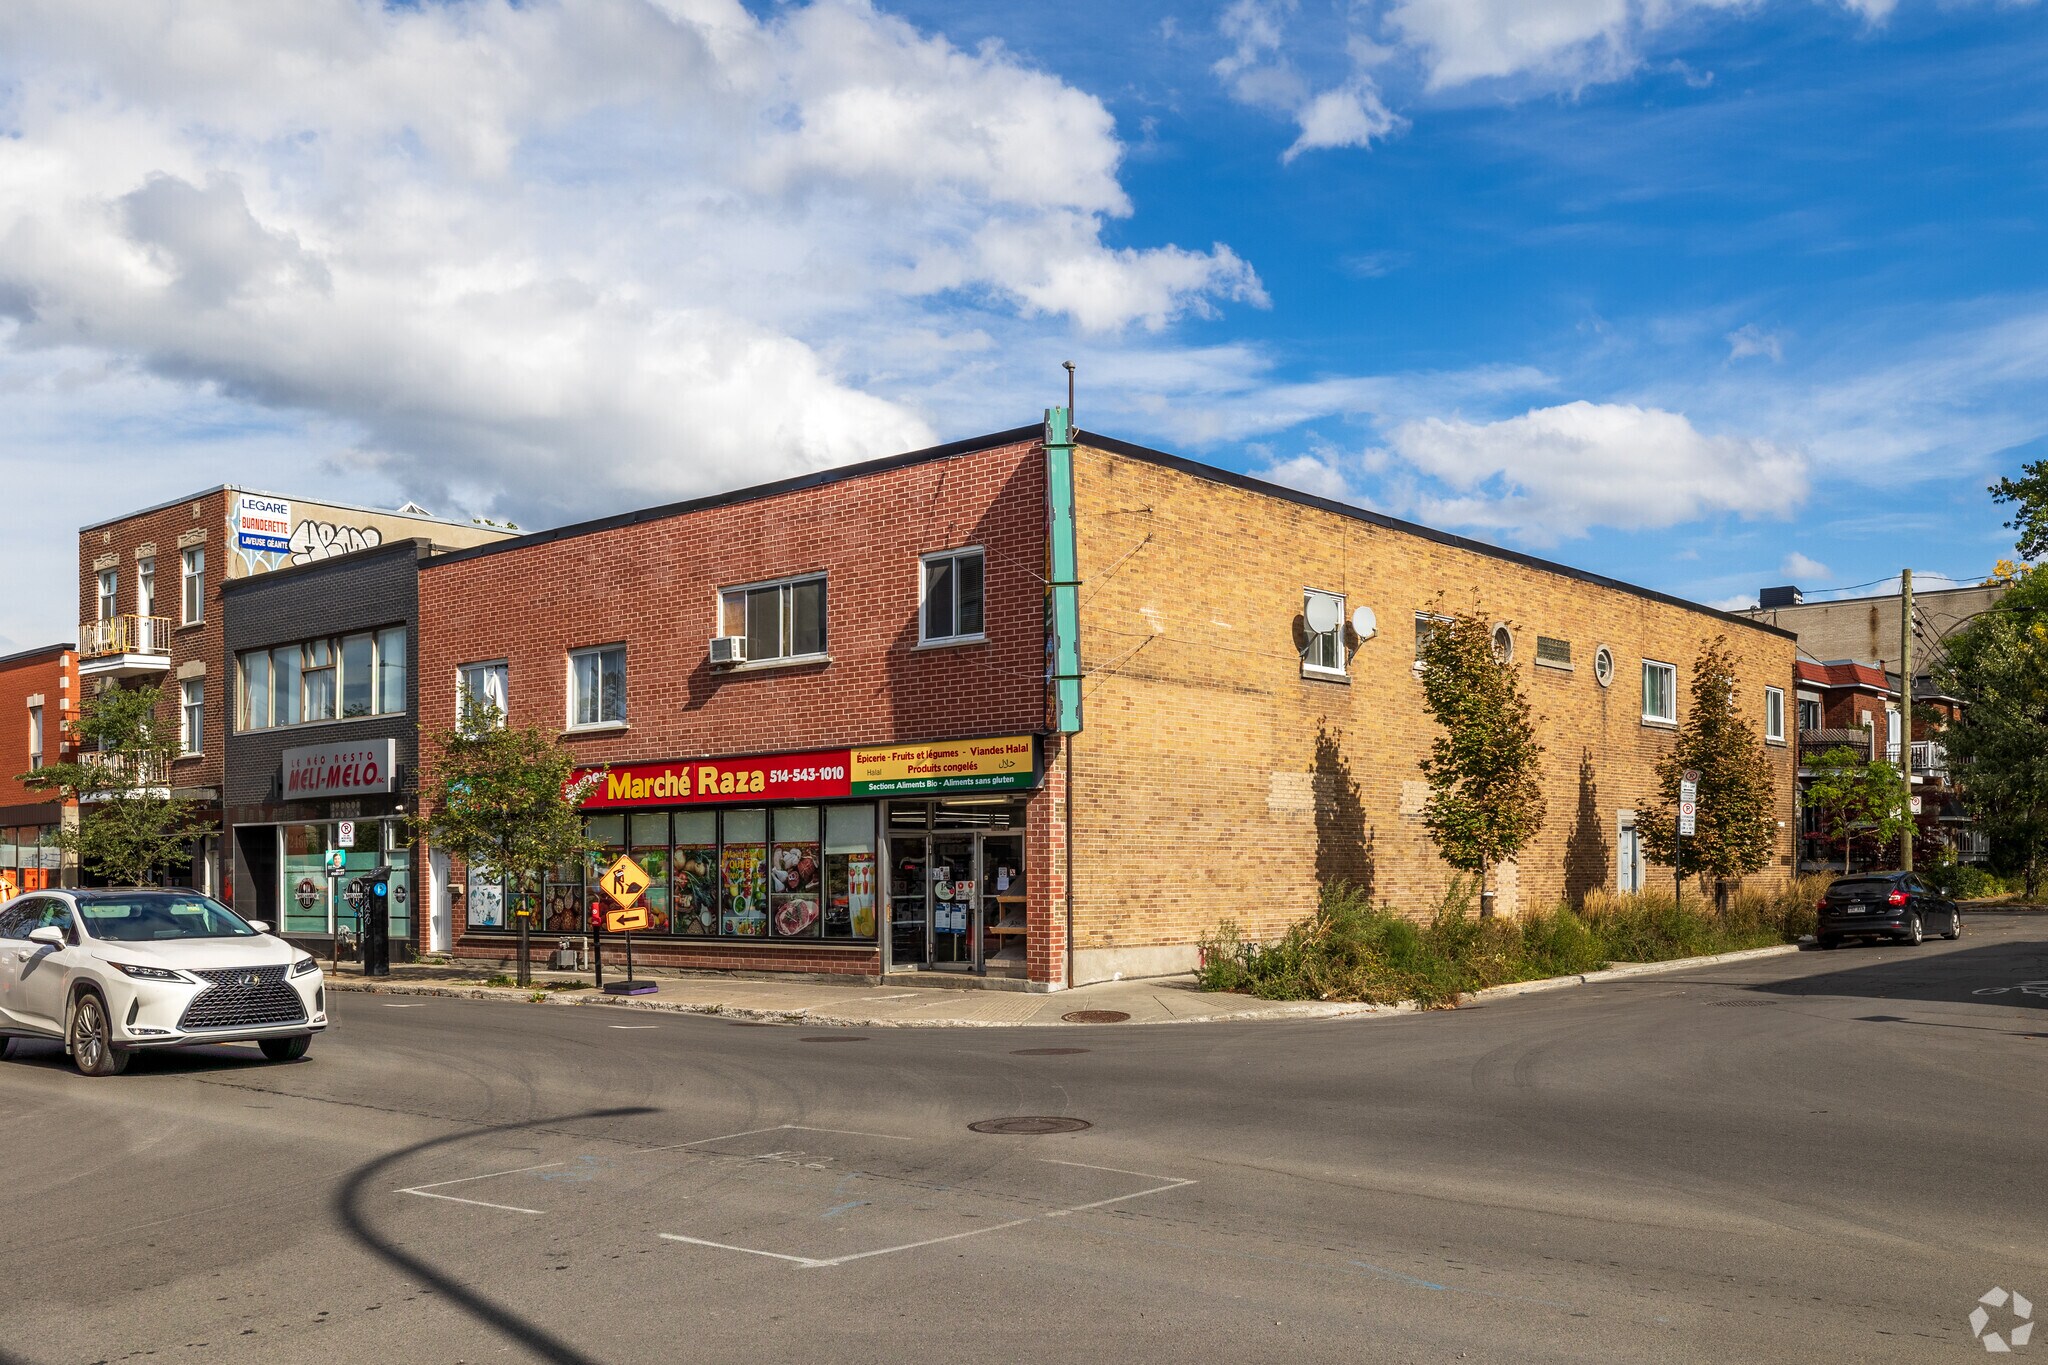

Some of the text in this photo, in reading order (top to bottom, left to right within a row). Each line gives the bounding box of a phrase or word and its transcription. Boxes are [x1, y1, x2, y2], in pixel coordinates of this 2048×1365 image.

[242, 499, 288, 515] LEGARE
[242, 516, 288, 535] BUANDERETTE
[242, 535, 288, 550] LAVEUSE GÉANTE
[291, 759, 300, 768] LE
[334, 751, 373, 764] RESTO
[856, 752, 886, 764] Épicerie
[892, 751, 915, 762] Fruits
[916, 751, 925, 760] et
[926, 749, 959, 760] légumes
[970, 745, 1004, 756] Viandes
[1006, 743, 1029, 753] Halal
[866, 768, 882, 776] Halal
[907, 761, 978, 774] Produits congelés
[607, 766, 691, 800] Marché
[698, 766, 766, 795] Raza
[769, 765, 845, 783] 514-543-1010
[868, 782, 895, 791] Sections
[896, 780, 926, 789] Aliments
[926, 779, 938, 788] Bio
[943, 777, 974, 787] Aliments
[975, 777, 991, 785] sans
[992, 775, 1015, 785] gluten
